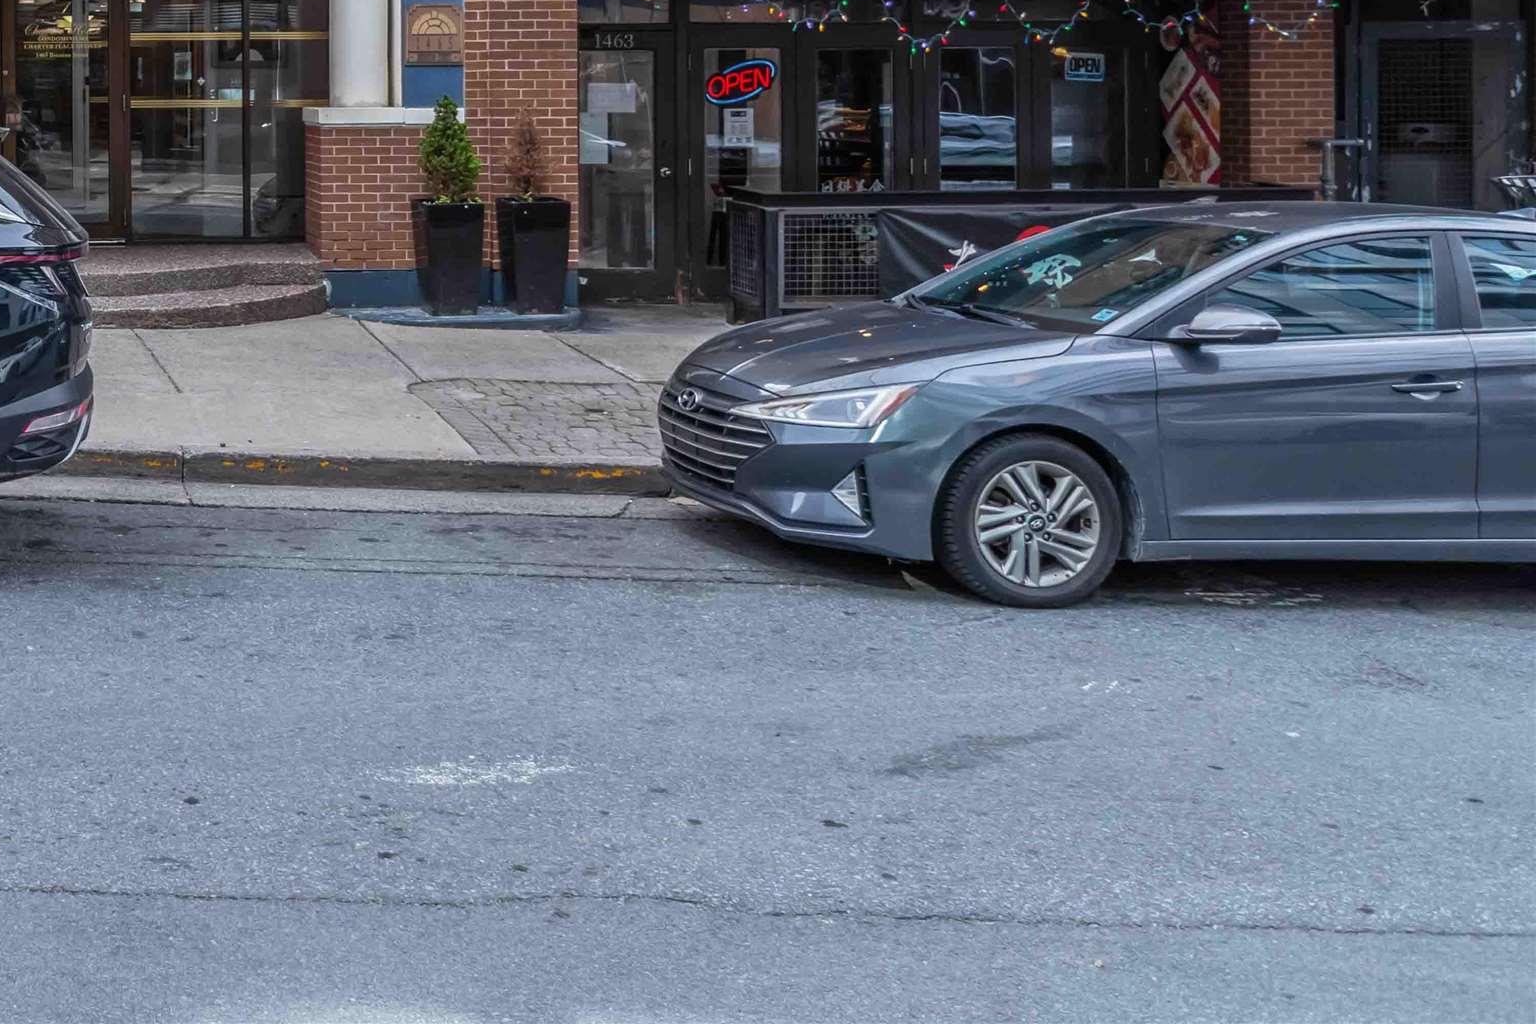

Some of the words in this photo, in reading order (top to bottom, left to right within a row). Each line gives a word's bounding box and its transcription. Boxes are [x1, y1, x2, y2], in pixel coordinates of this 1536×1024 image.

[594, 33, 635, 50] 1463
[1070, 57, 1101, 73] OPEN
[706, 66, 771, 98] OPEN
